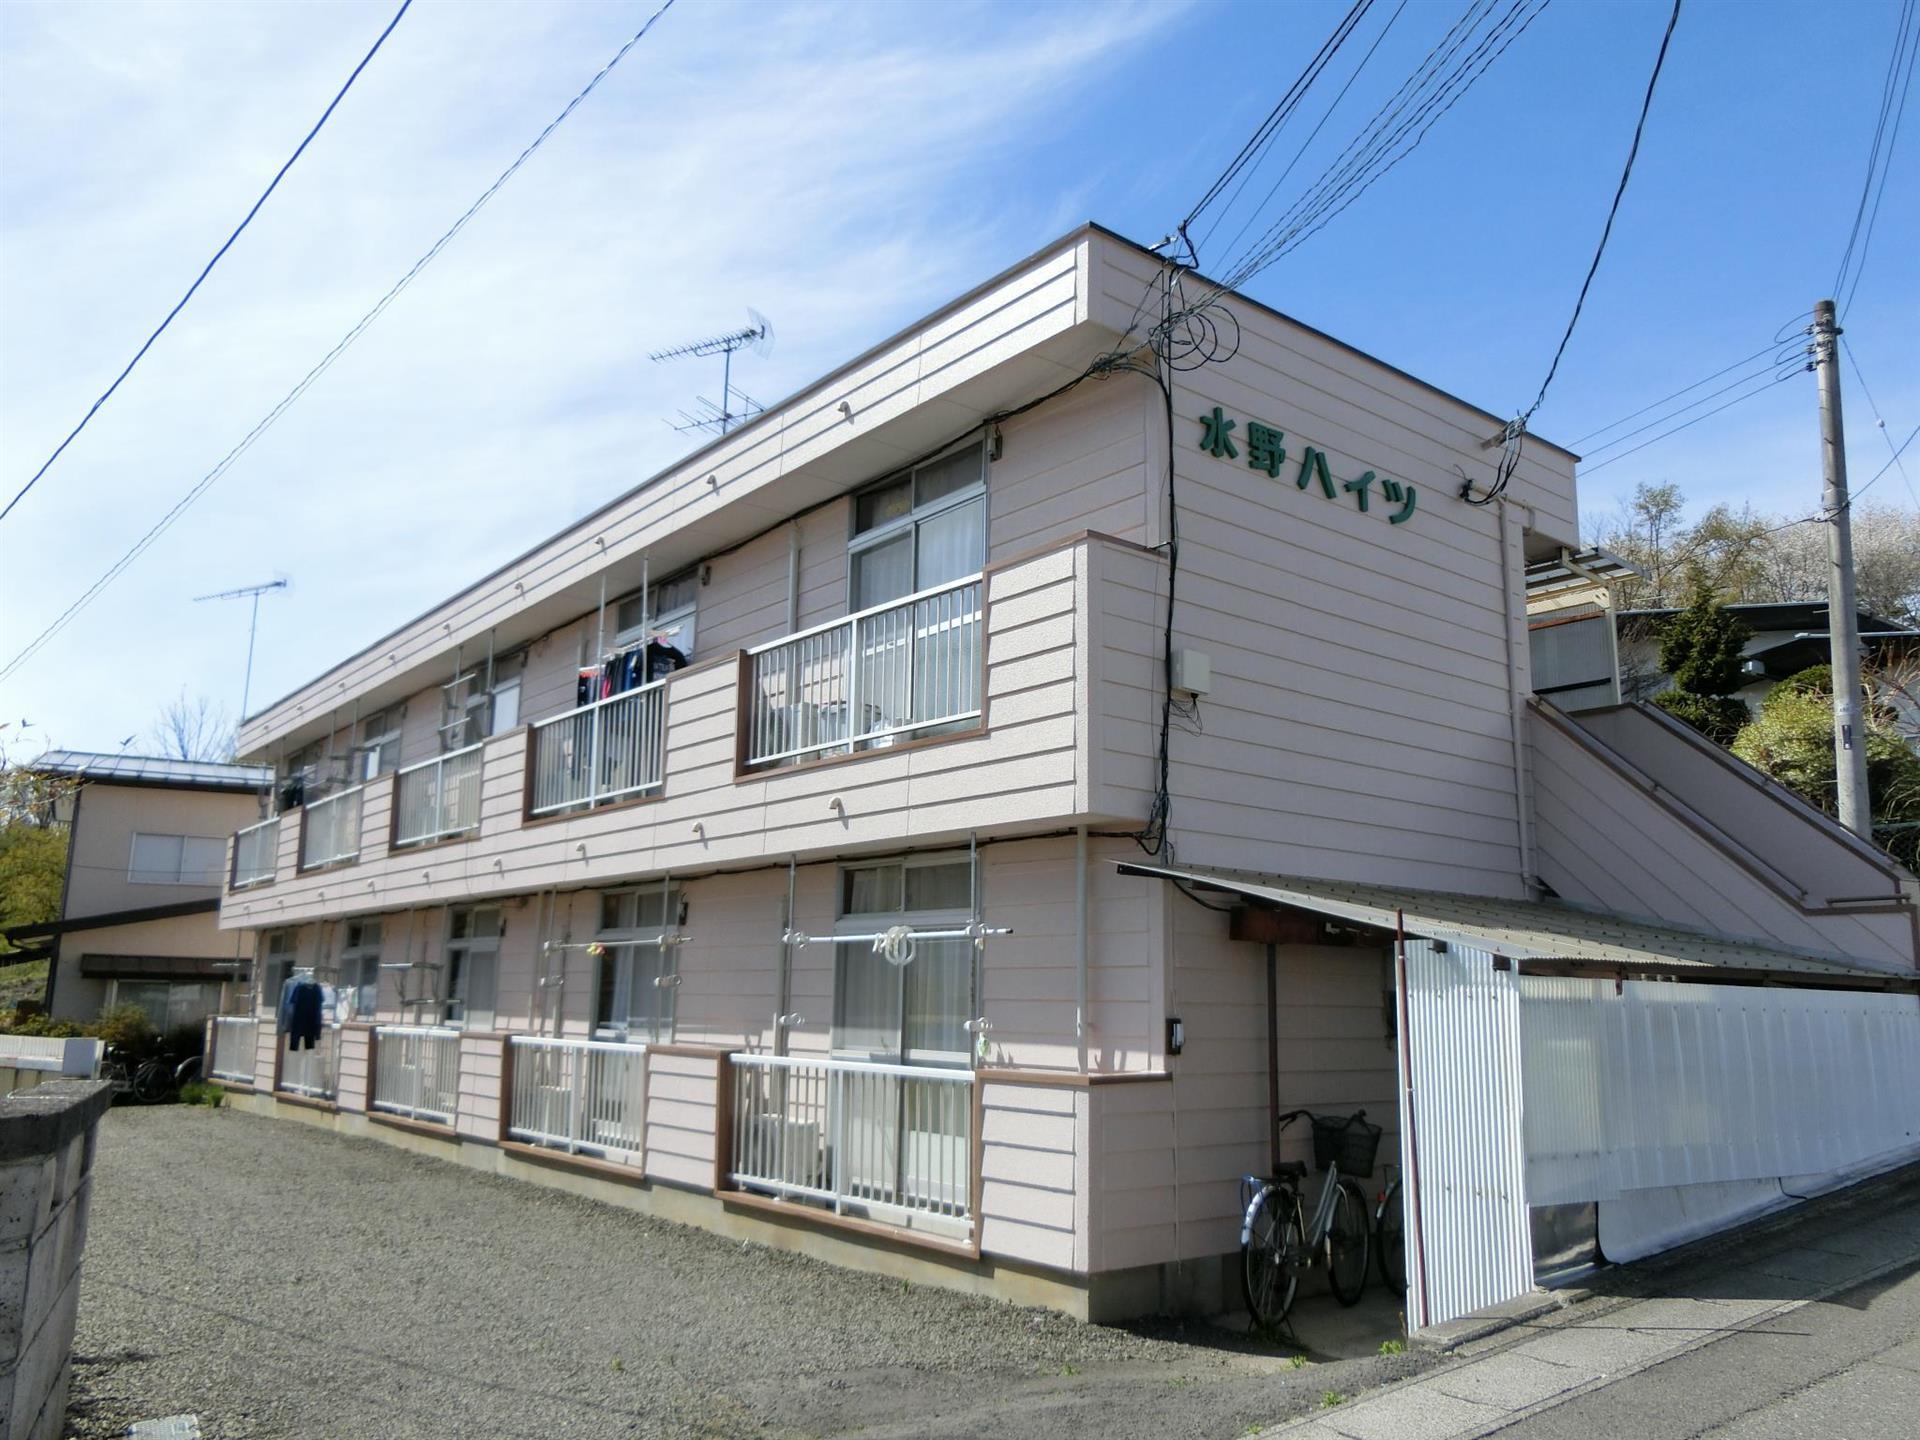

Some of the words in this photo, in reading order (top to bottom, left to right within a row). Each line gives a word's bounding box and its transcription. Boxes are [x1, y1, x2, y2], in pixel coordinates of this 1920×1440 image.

[1199, 406, 1416, 525] 水野ハイツ
